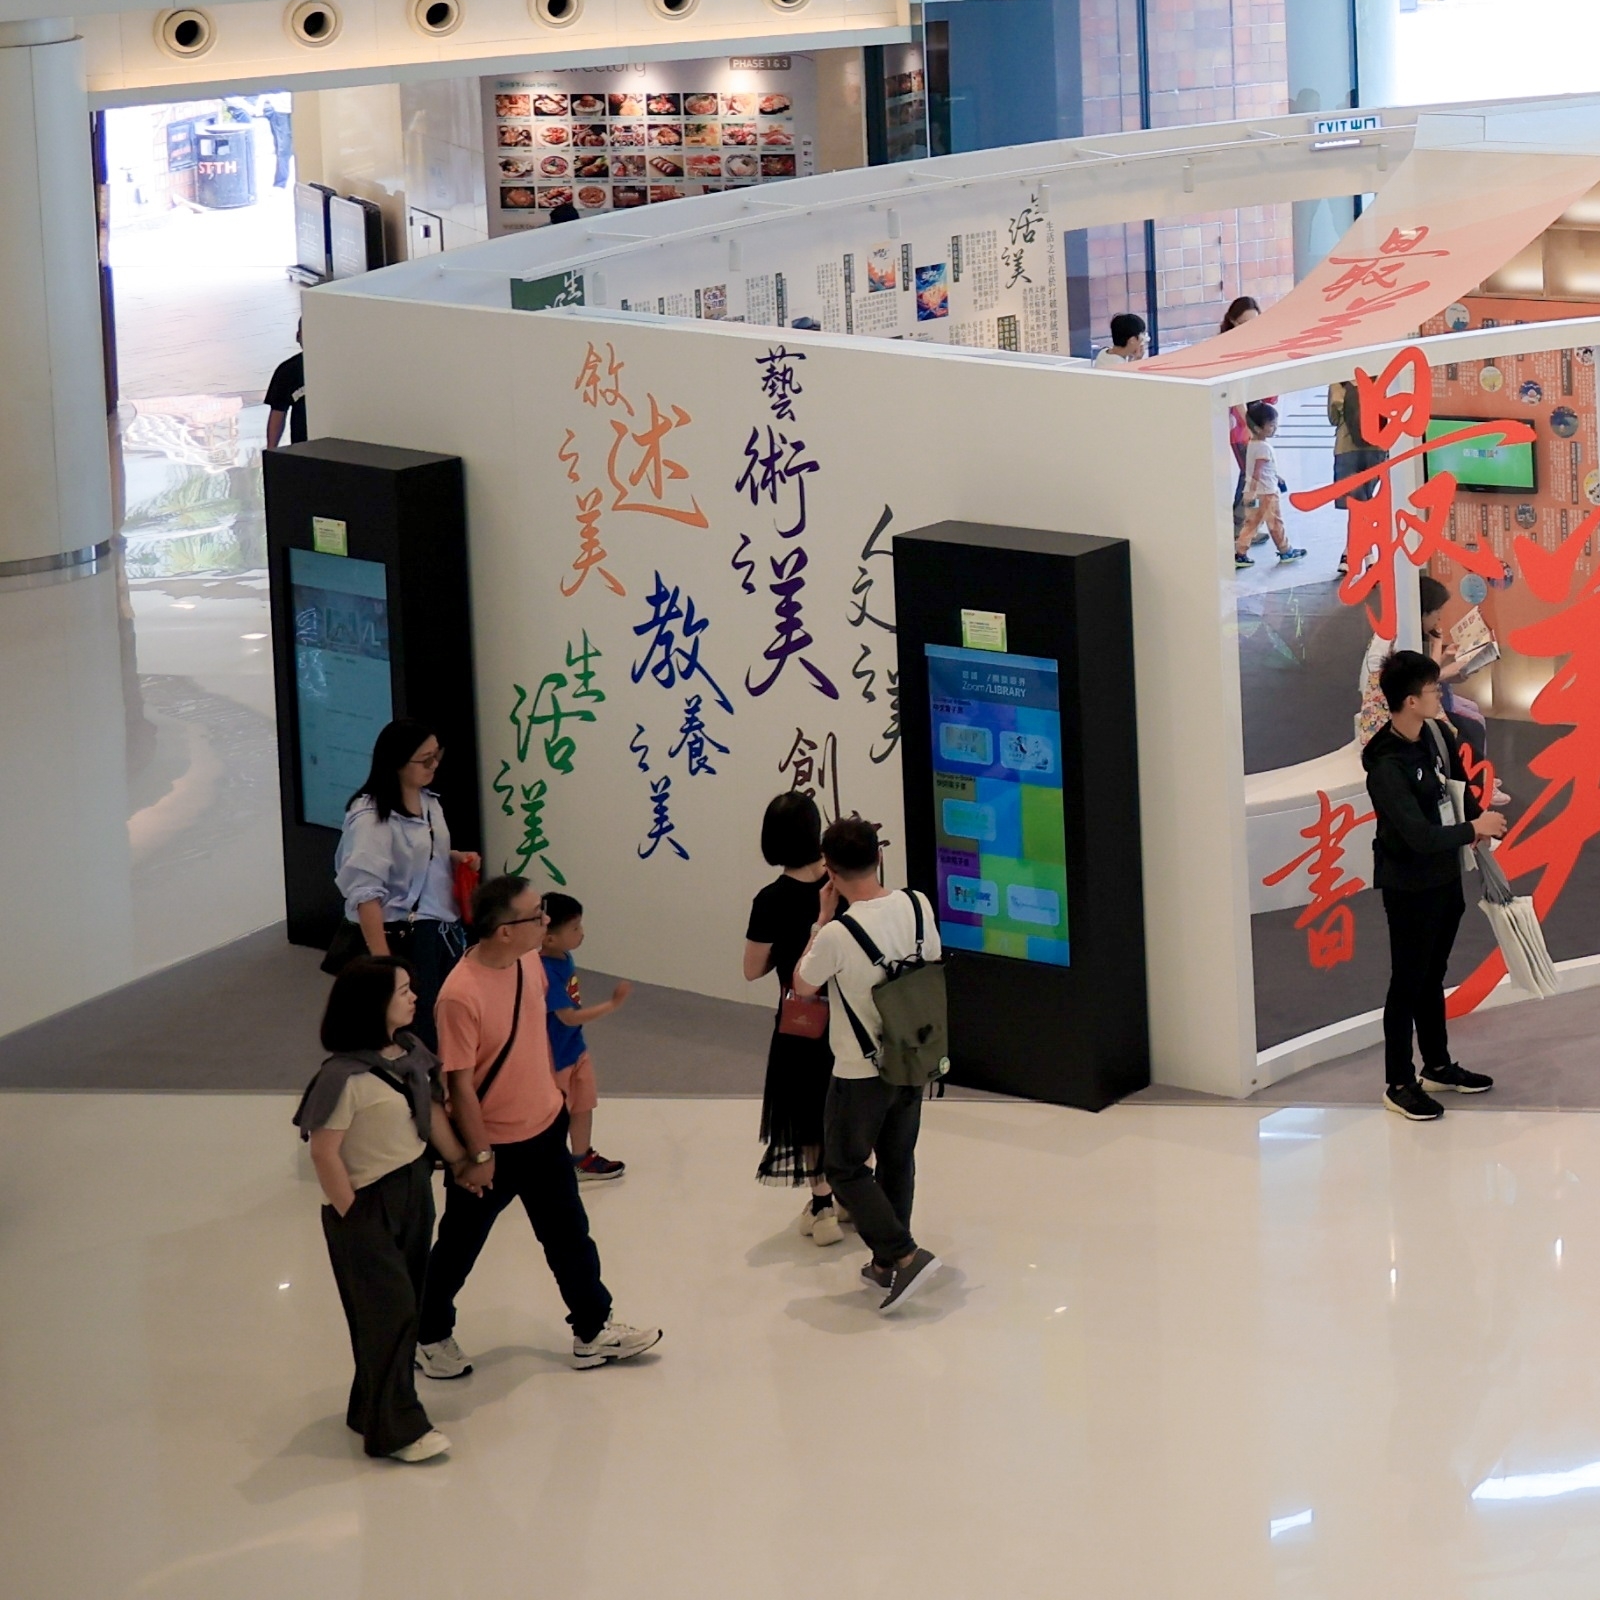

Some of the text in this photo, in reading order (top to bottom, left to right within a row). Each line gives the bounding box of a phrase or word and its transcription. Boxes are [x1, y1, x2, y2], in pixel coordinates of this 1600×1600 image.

[732, 58, 765, 69] PHASE
[729, 343, 840, 701] 藝術之美
[491, 626, 606, 887] 生活之美
[628, 568, 736, 862] 教養之美
